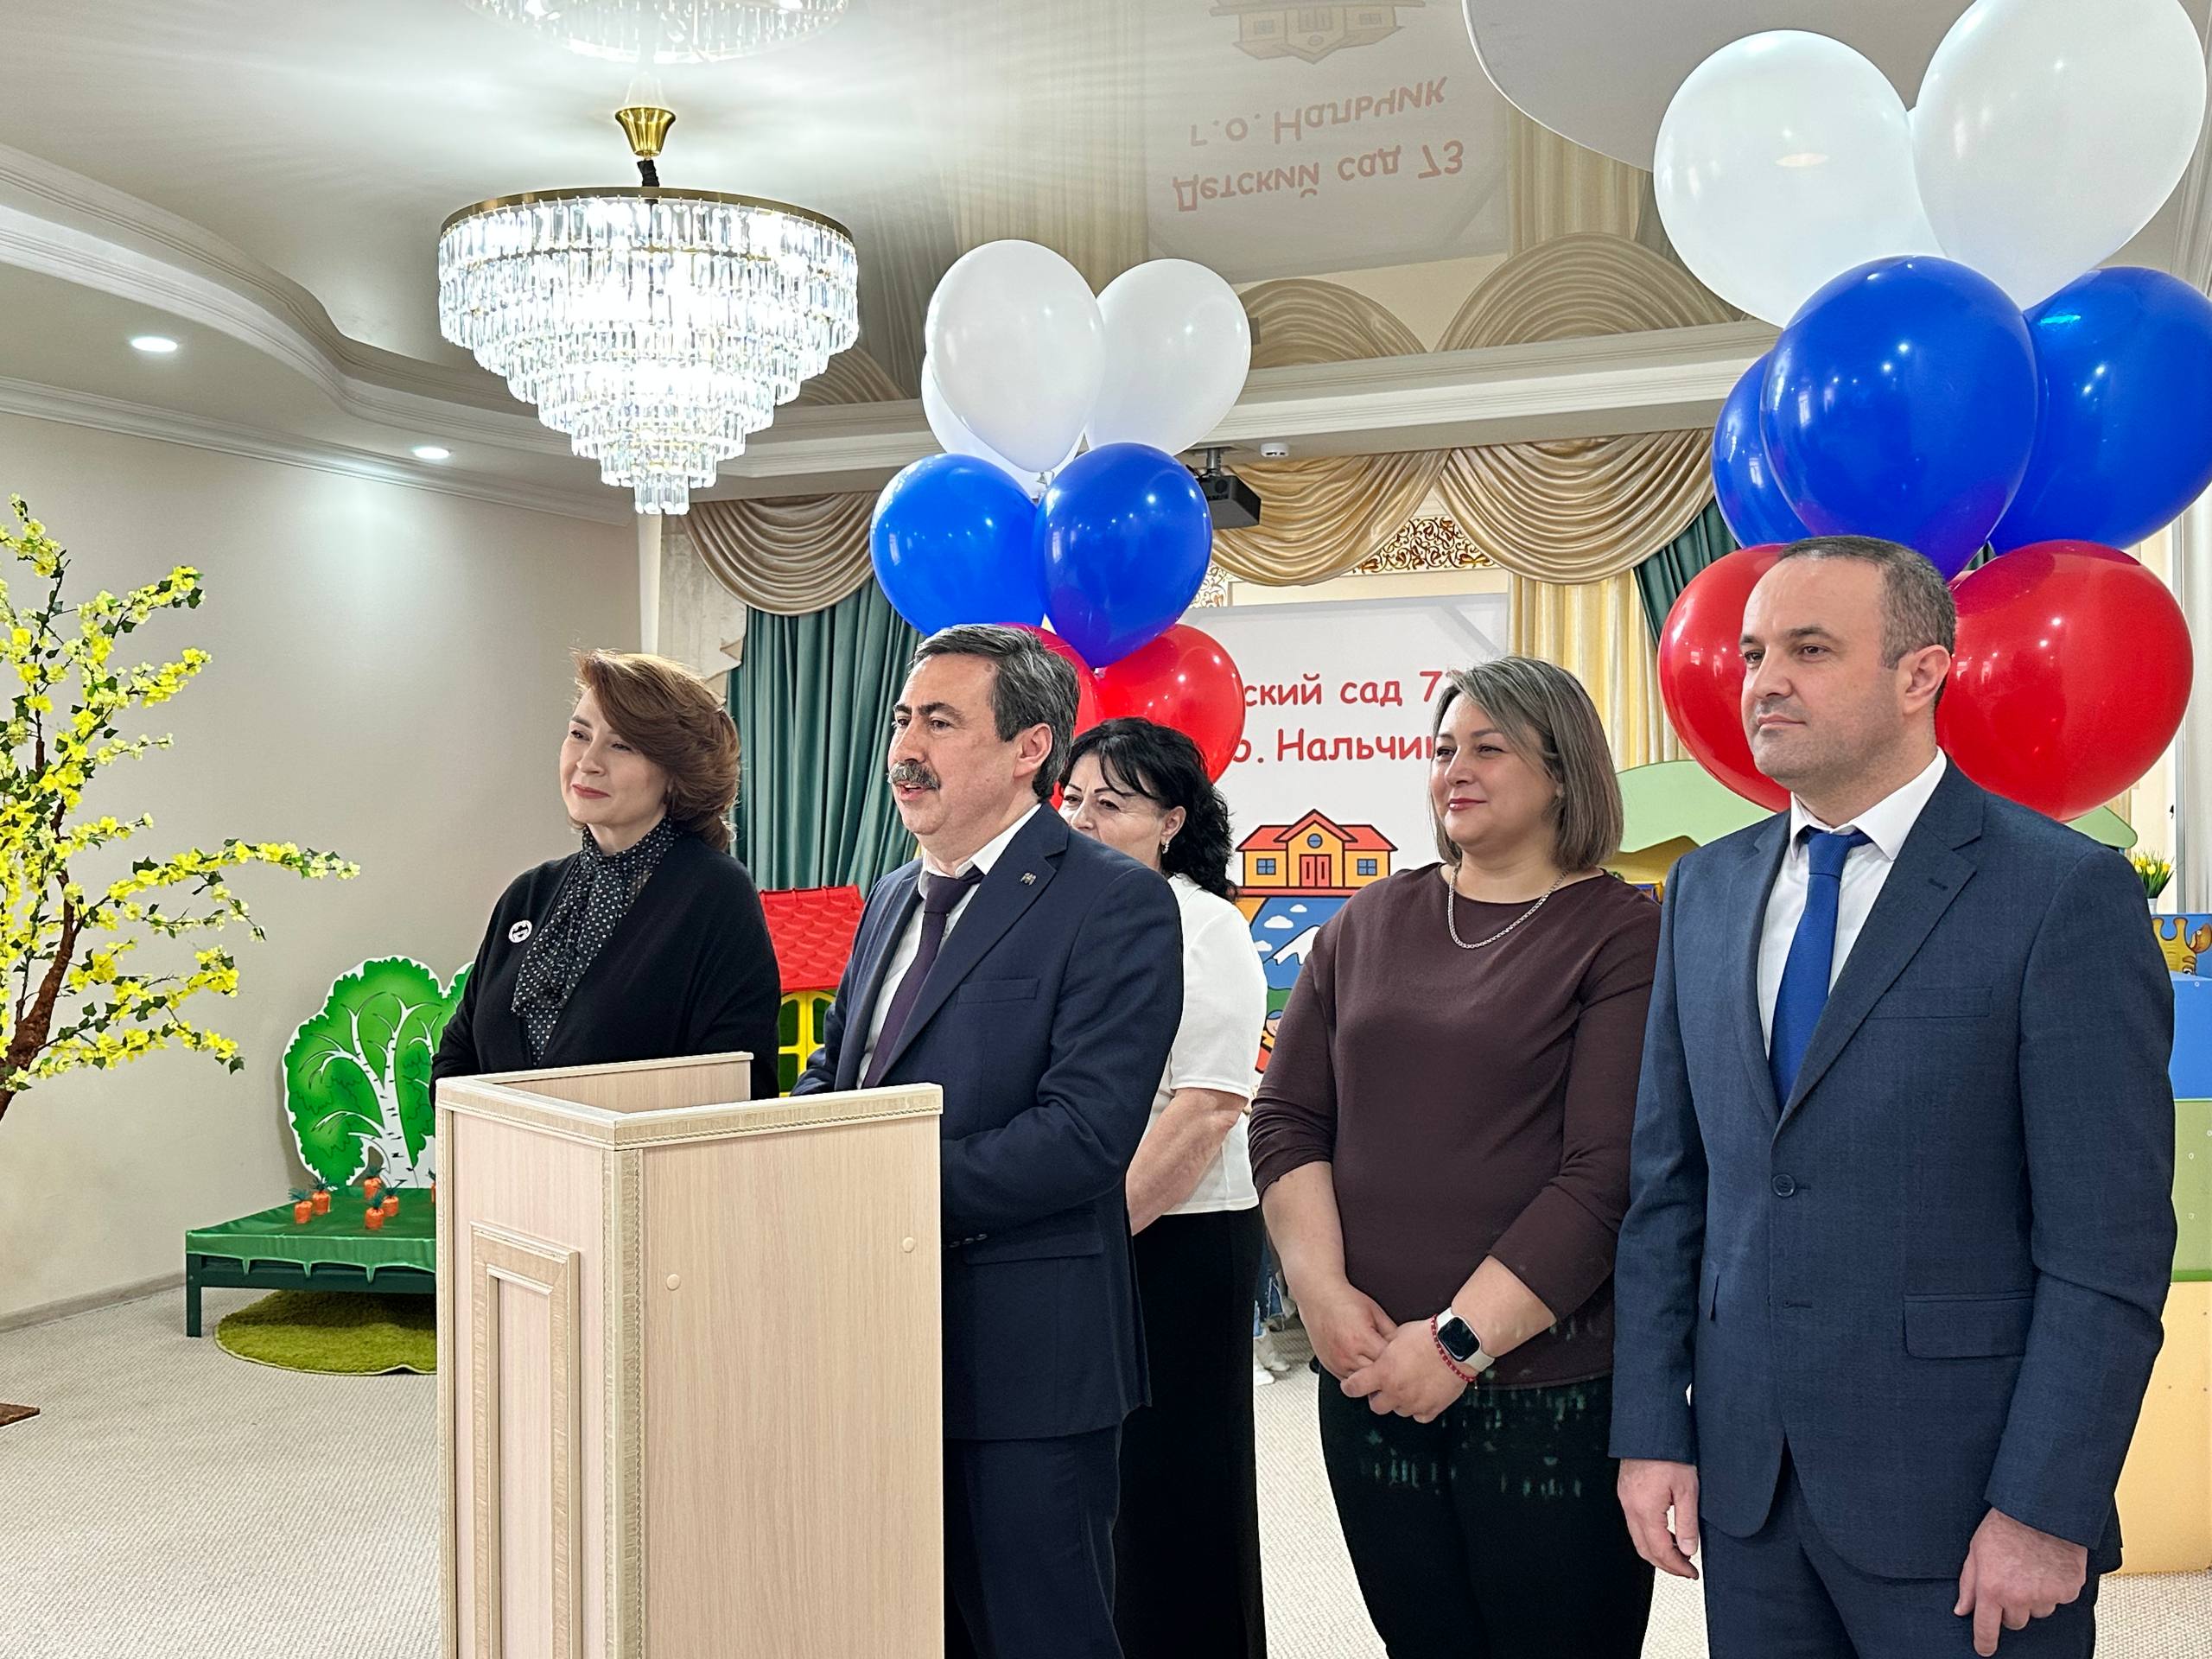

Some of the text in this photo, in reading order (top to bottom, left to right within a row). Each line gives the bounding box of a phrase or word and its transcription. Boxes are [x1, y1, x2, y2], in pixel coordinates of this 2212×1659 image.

[1244, 671, 1464, 707] ский сад 7
[1232, 739, 1264, 764] о.
